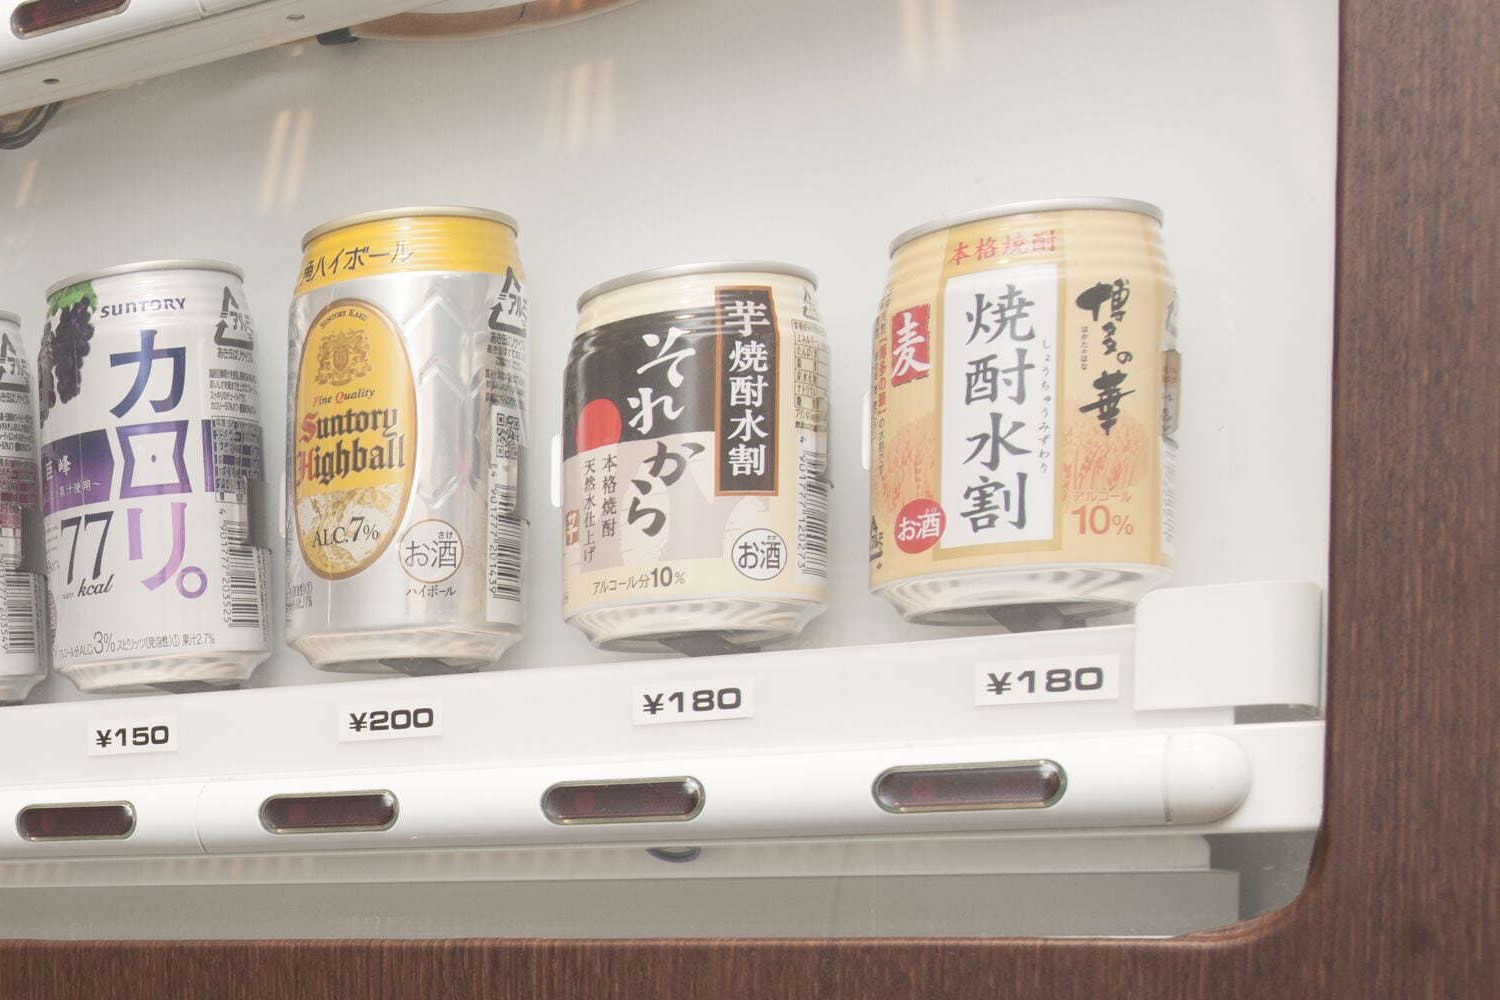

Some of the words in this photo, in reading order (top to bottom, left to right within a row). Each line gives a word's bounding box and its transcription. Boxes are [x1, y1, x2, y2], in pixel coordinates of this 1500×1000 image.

[948, 229, 1057, 266] 本格焼酎
[101, 298, 187, 319] SUNTORY
[892, 312, 932, 378] 麦
[312, 394, 333, 407] Fine
[336, 387, 376, 404] Quality
[724, 300, 771, 476] 芋焼酎水割
[959, 284, 1037, 533] 焼酎水割
[300, 407, 400, 443] Suntory
[627, 326, 706, 537] それから
[296, 435, 406, 487] Highball
[583, 457, 597, 564] 天然水仕上げ
[601, 453, 619, 538] 本格焼酎
[1073, 490, 1132, 503] アルコール
[897, 510, 941, 542] お酒
[1071, 504, 1134, 536] 10%
[61, 511, 115, 585] 77
[404, 540, 459, 569] お酒
[738, 541, 782, 571] お酒
[77, 574, 115, 598] kcal
[405, 585, 457, 599] ハイボール
[987, 666, 1105, 696] ¥180
[642, 687, 744, 715] ¥180
[348, 707, 436, 733] ¥200
[95, 725, 171, 750] ¥150
